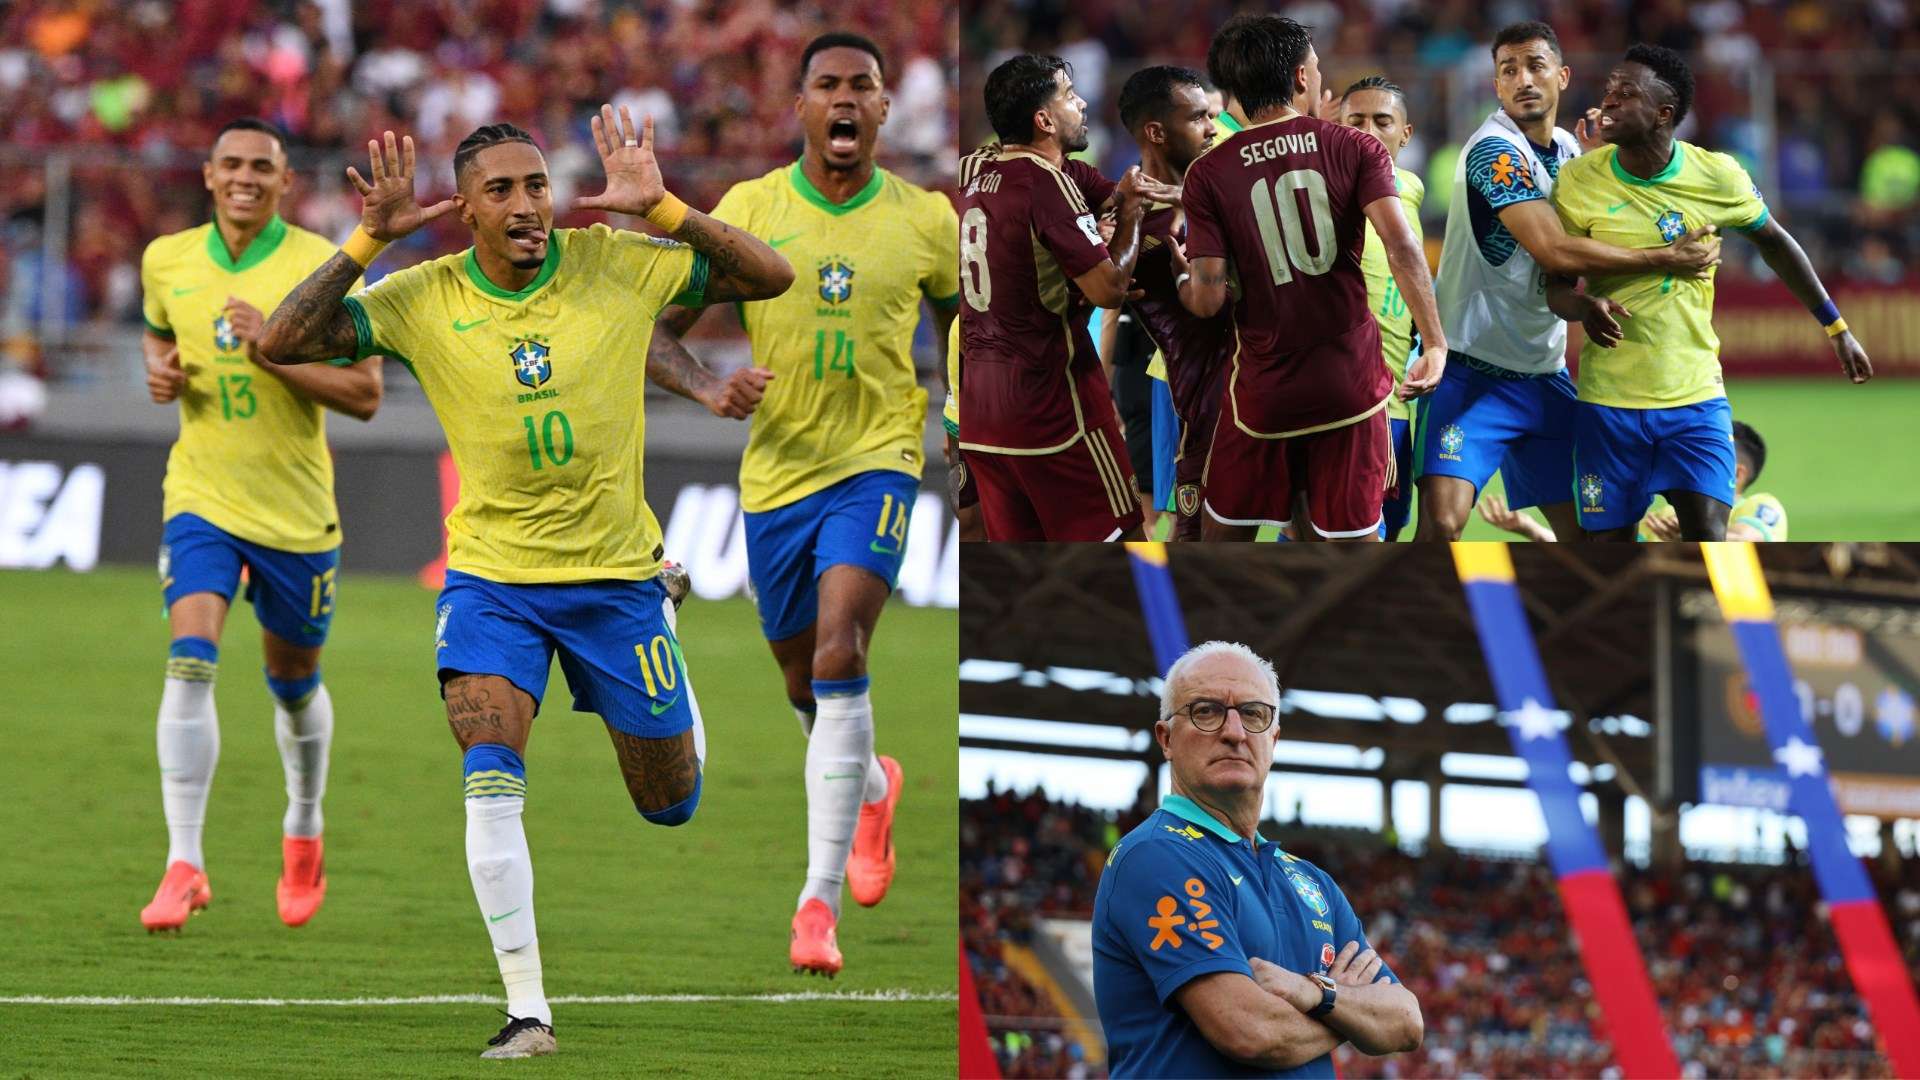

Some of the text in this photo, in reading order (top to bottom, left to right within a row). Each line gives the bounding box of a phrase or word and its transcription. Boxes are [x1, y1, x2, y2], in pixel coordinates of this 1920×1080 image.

[1240, 131, 1318, 167] SEGOVIA
[1251, 169, 1338, 286] 10
[960, 208, 992, 312] 8
[524, 359, 540, 368] CBF
[814, 329, 854, 381] 14
[218, 375, 256, 421] 13
[517, 388, 560, 404] BRASIL
[524, 411, 574, 470] 10
[0, 462, 104, 571] EA
[876, 493, 906, 551] 14
[634, 635, 676, 697] 10
[1185, 878, 1224, 950] vivo
